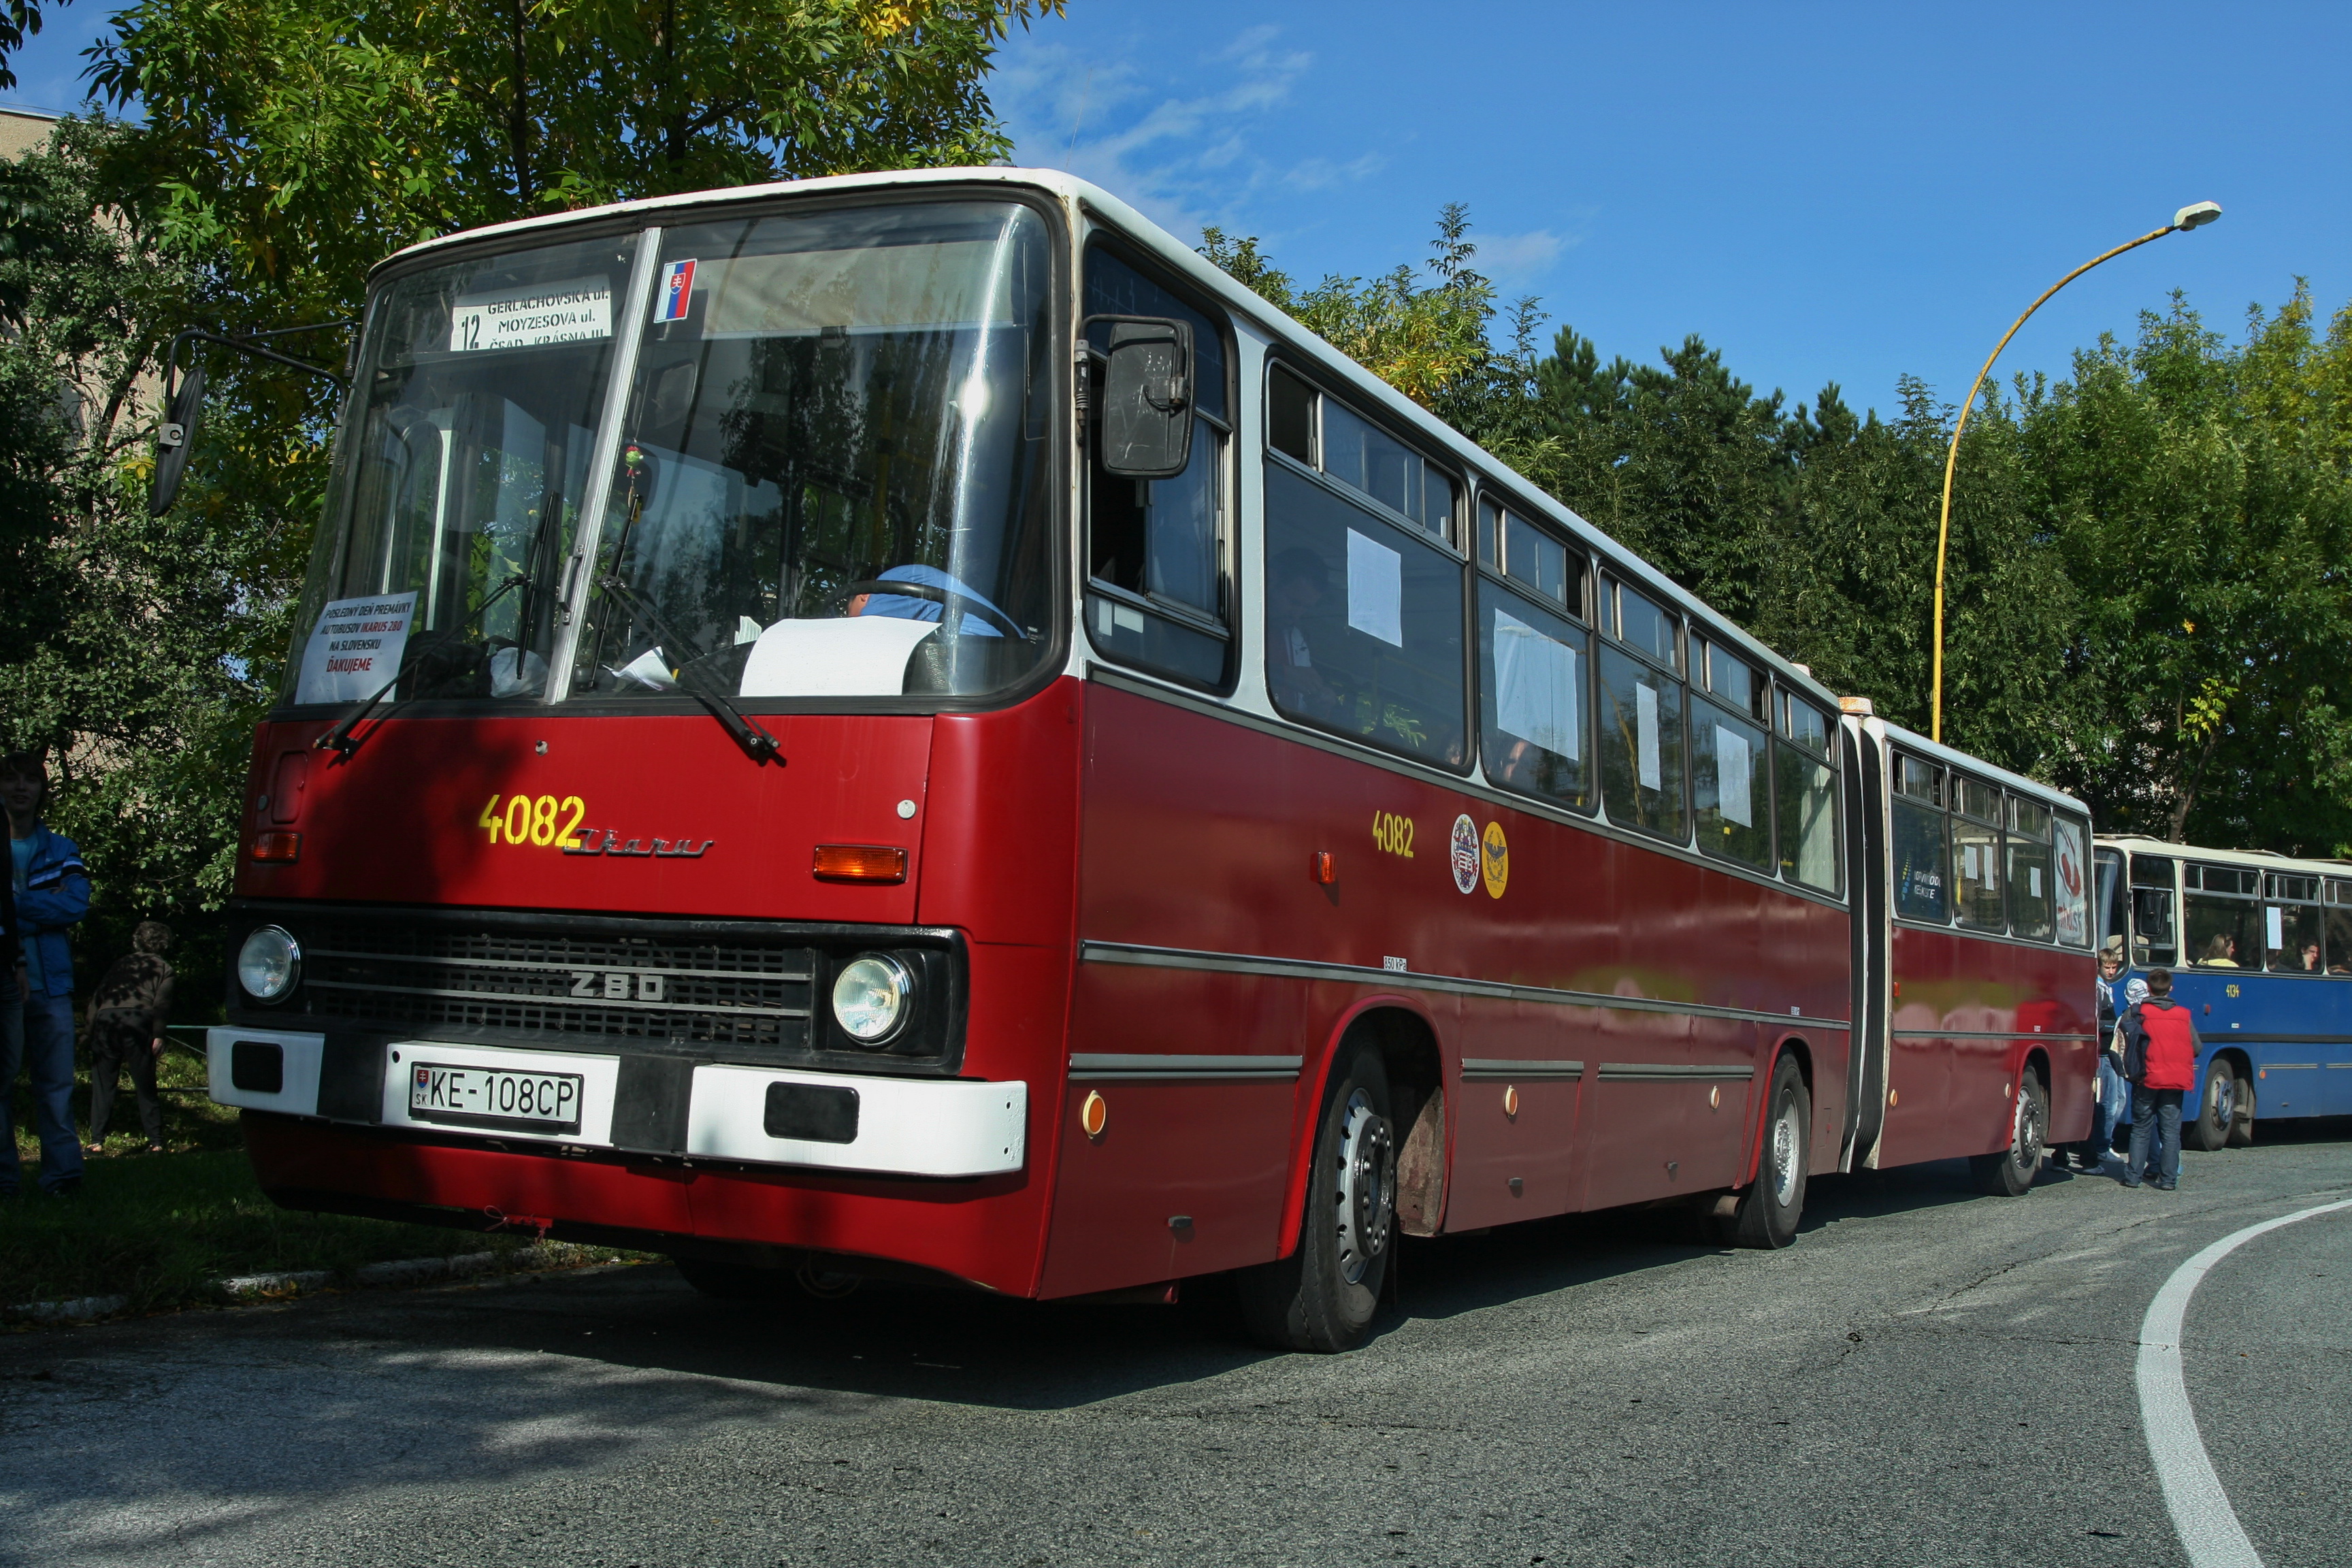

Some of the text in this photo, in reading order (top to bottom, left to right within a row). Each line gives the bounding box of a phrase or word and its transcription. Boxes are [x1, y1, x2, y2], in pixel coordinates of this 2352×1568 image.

[488, 285, 608, 315] GERLACHOVSKÁ ul.
[461, 314, 480, 350] 12
[498, 308, 595, 333] MOYZESOVA ul.
[324, 600, 412, 619] POSLEDNÝ DEŇ PREMÁVKY
[321, 620, 403, 635] AUTOBUSOV IKARUS 280
[329, 639, 382, 651] NA SLOVENSKU
[326, 655, 373, 674] ĎAKUJEME
[478, 794, 585, 848] 4082
[1373, 810, 1414, 858] 4082
[561, 828, 717, 856] Ikarus
[415, 1093, 428, 1106] SK
[430, 1071, 574, 1118] KE-108CP
